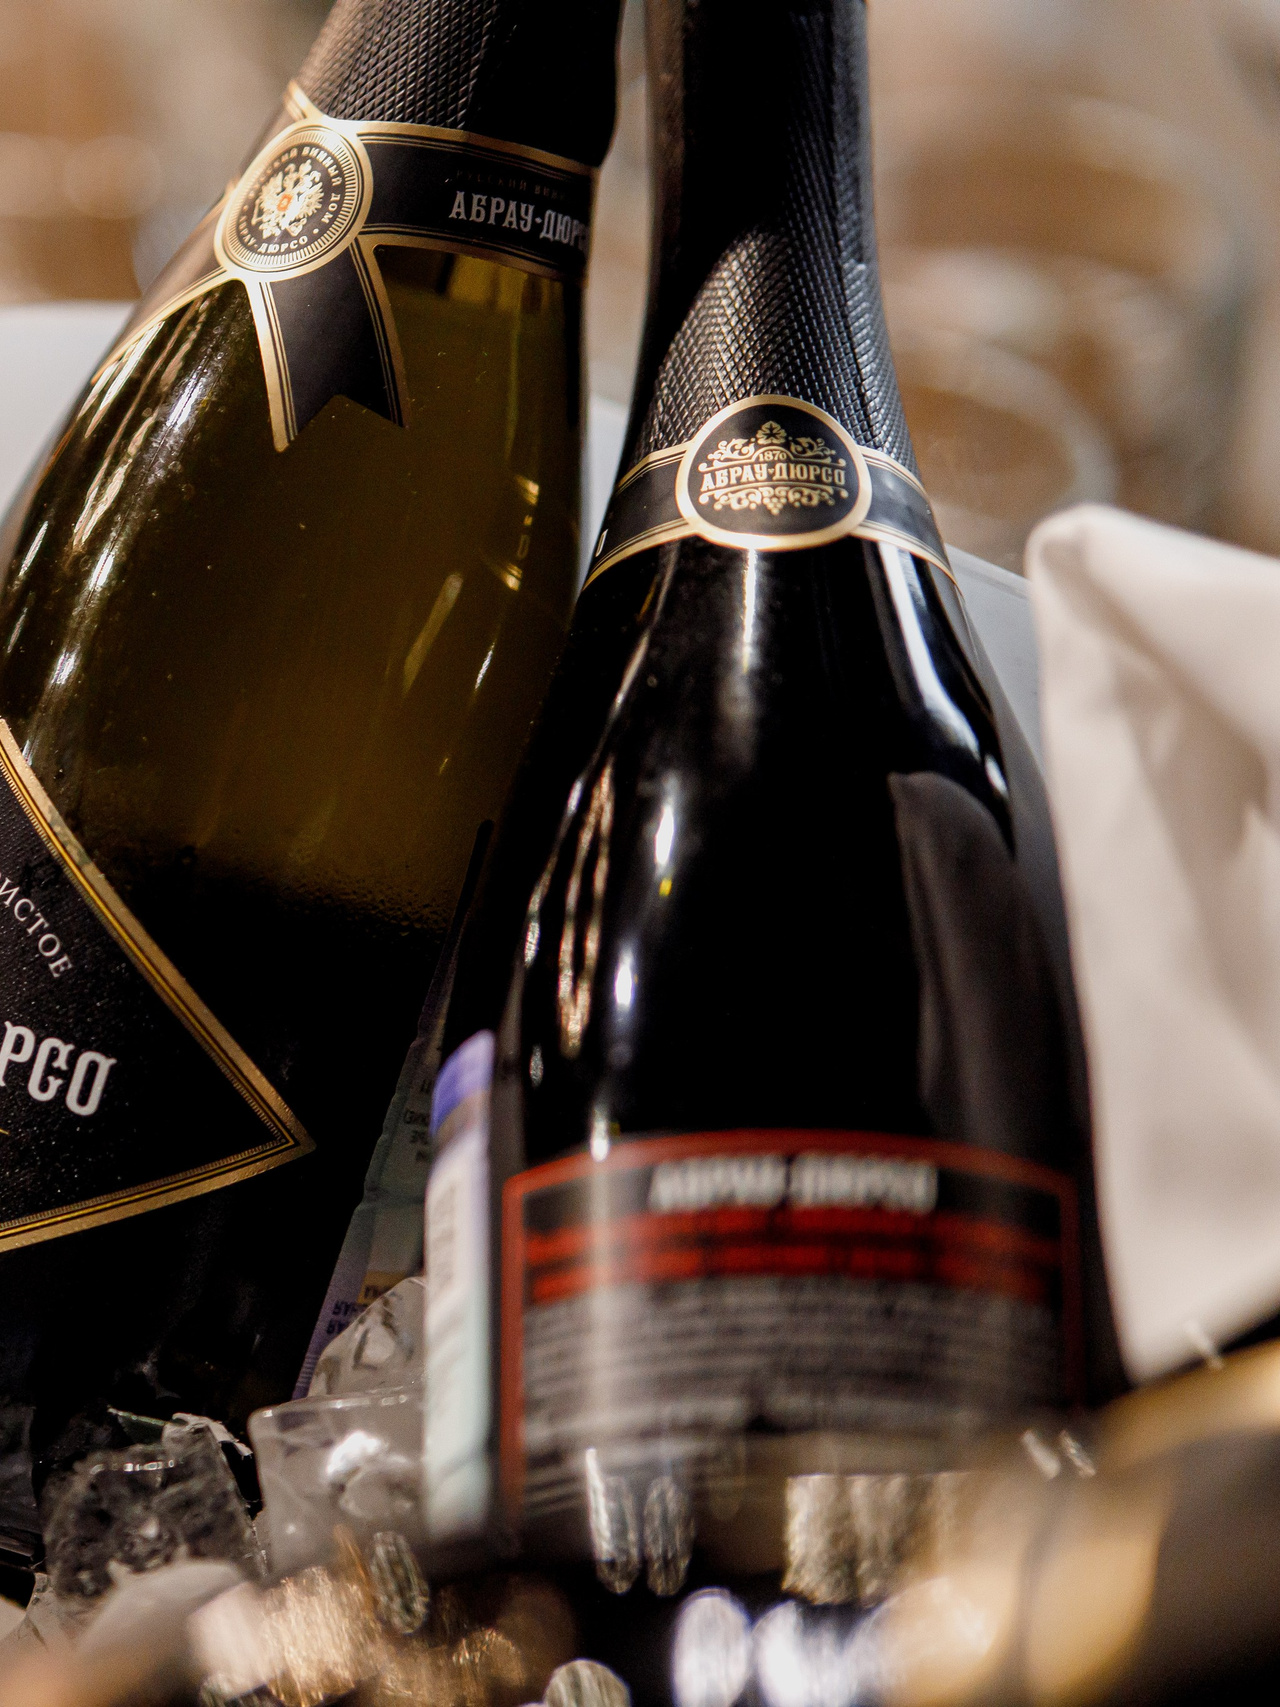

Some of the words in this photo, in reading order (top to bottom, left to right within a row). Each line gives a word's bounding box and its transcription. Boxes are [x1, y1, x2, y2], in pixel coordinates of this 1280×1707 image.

[301, 145, 343, 187] ВИННЫЙ
[321, 194, 341, 224] ДОМ
[758, 449, 787, 462] 1870
